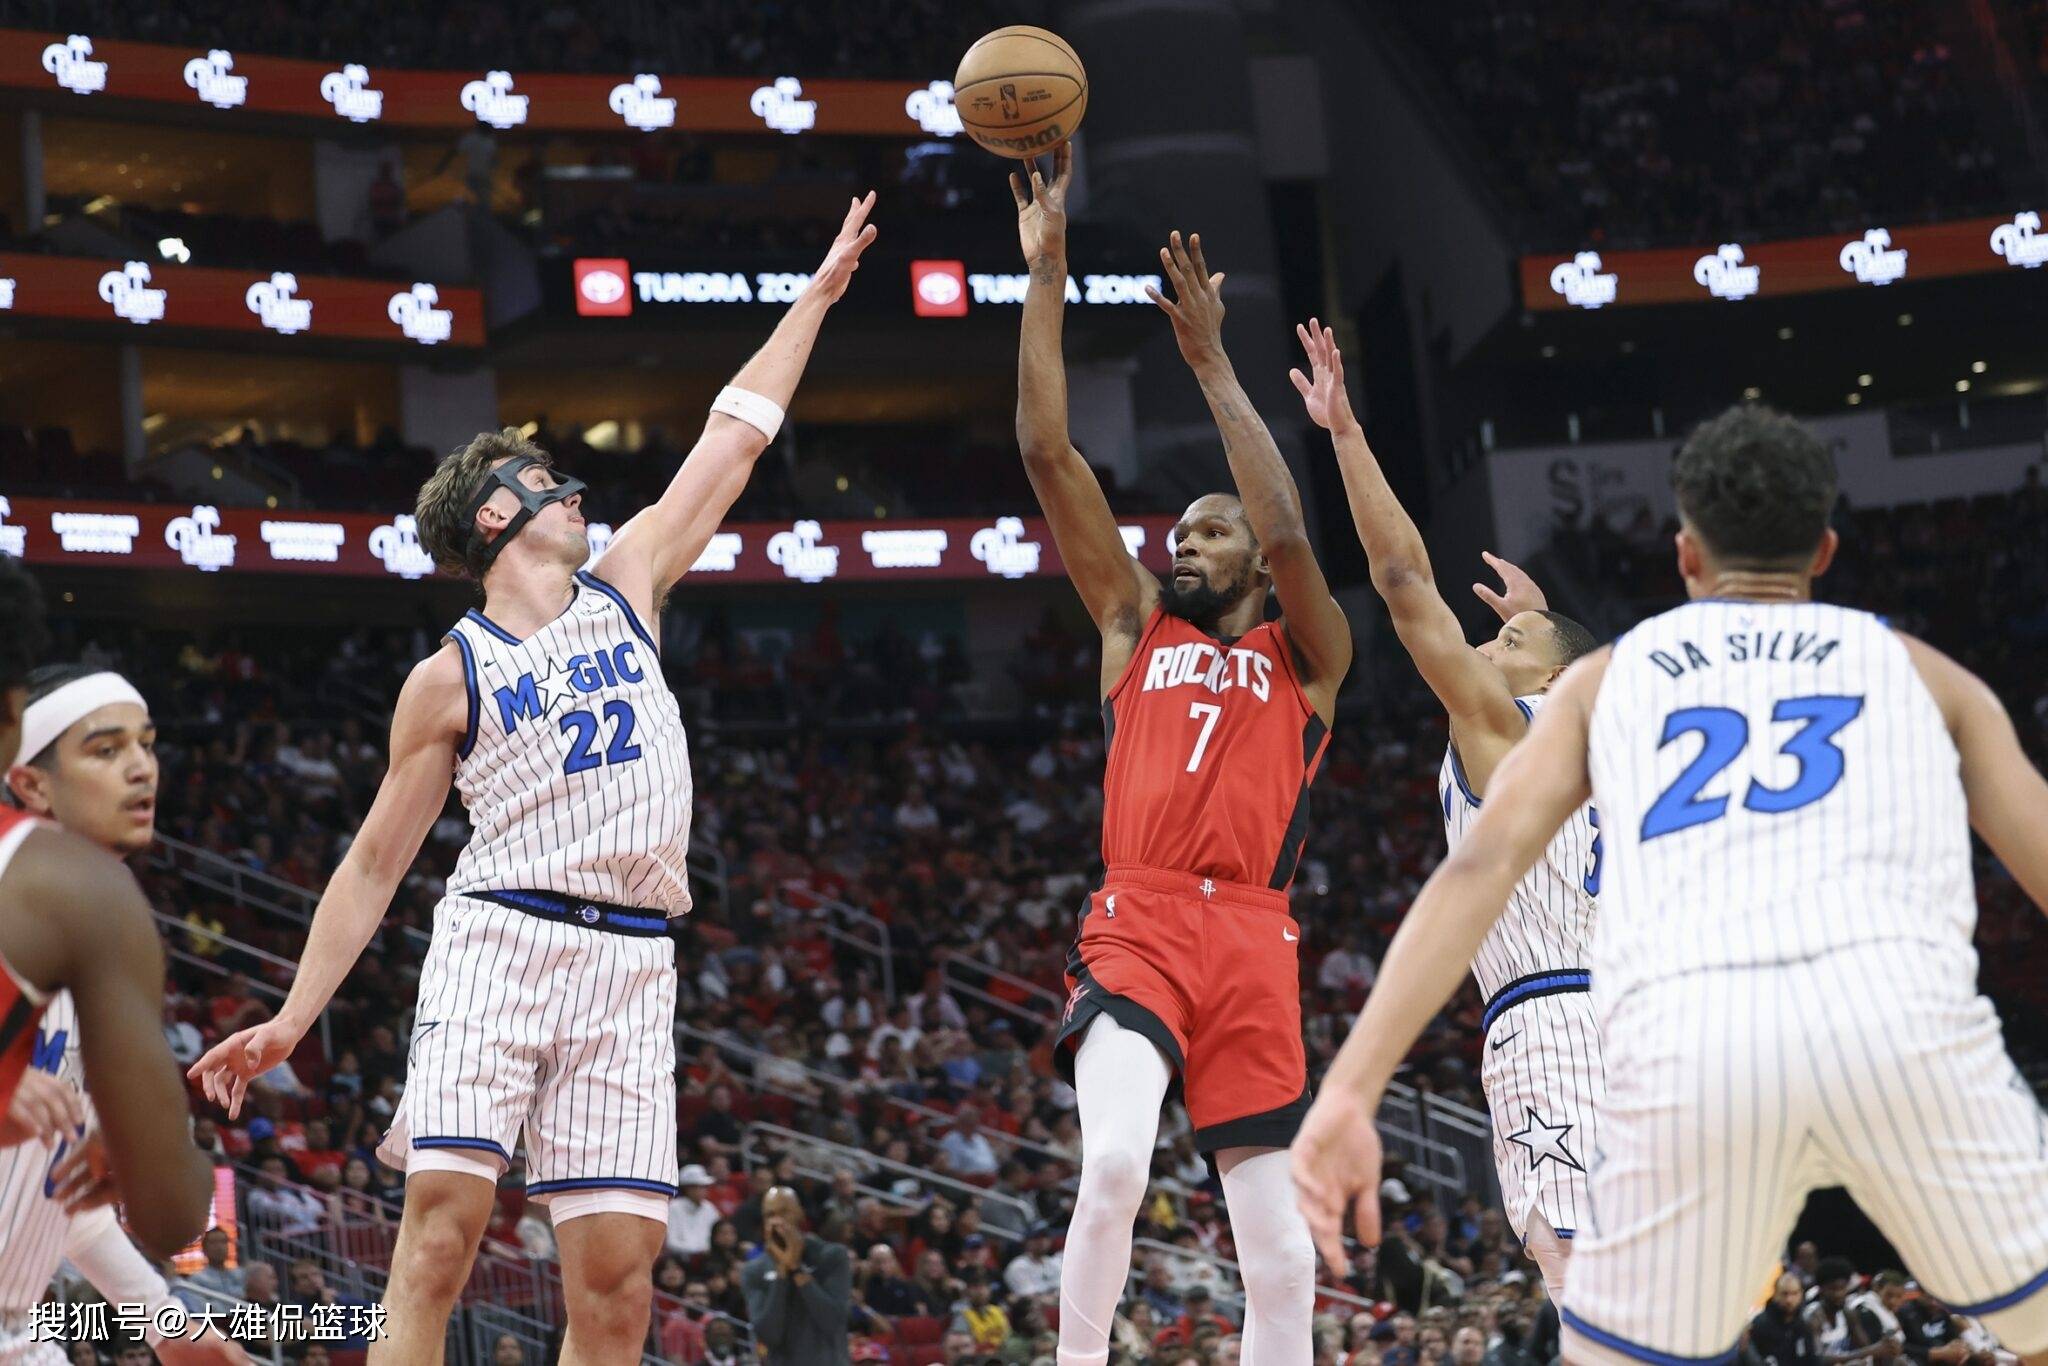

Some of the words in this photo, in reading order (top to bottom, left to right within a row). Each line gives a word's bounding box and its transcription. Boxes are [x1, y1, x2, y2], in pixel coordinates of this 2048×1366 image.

[633, 272, 753, 302] TUNDRA
[968, 274, 1081, 303] TUNA
[1142, 641, 1272, 704] ROCKETS
[1648, 640, 1711, 679] DA
[1725, 629, 1841, 667] SILVA
[558, 699, 642, 776] 22
[1185, 701, 1222, 773] 7
[1639, 693, 1866, 844] 23
